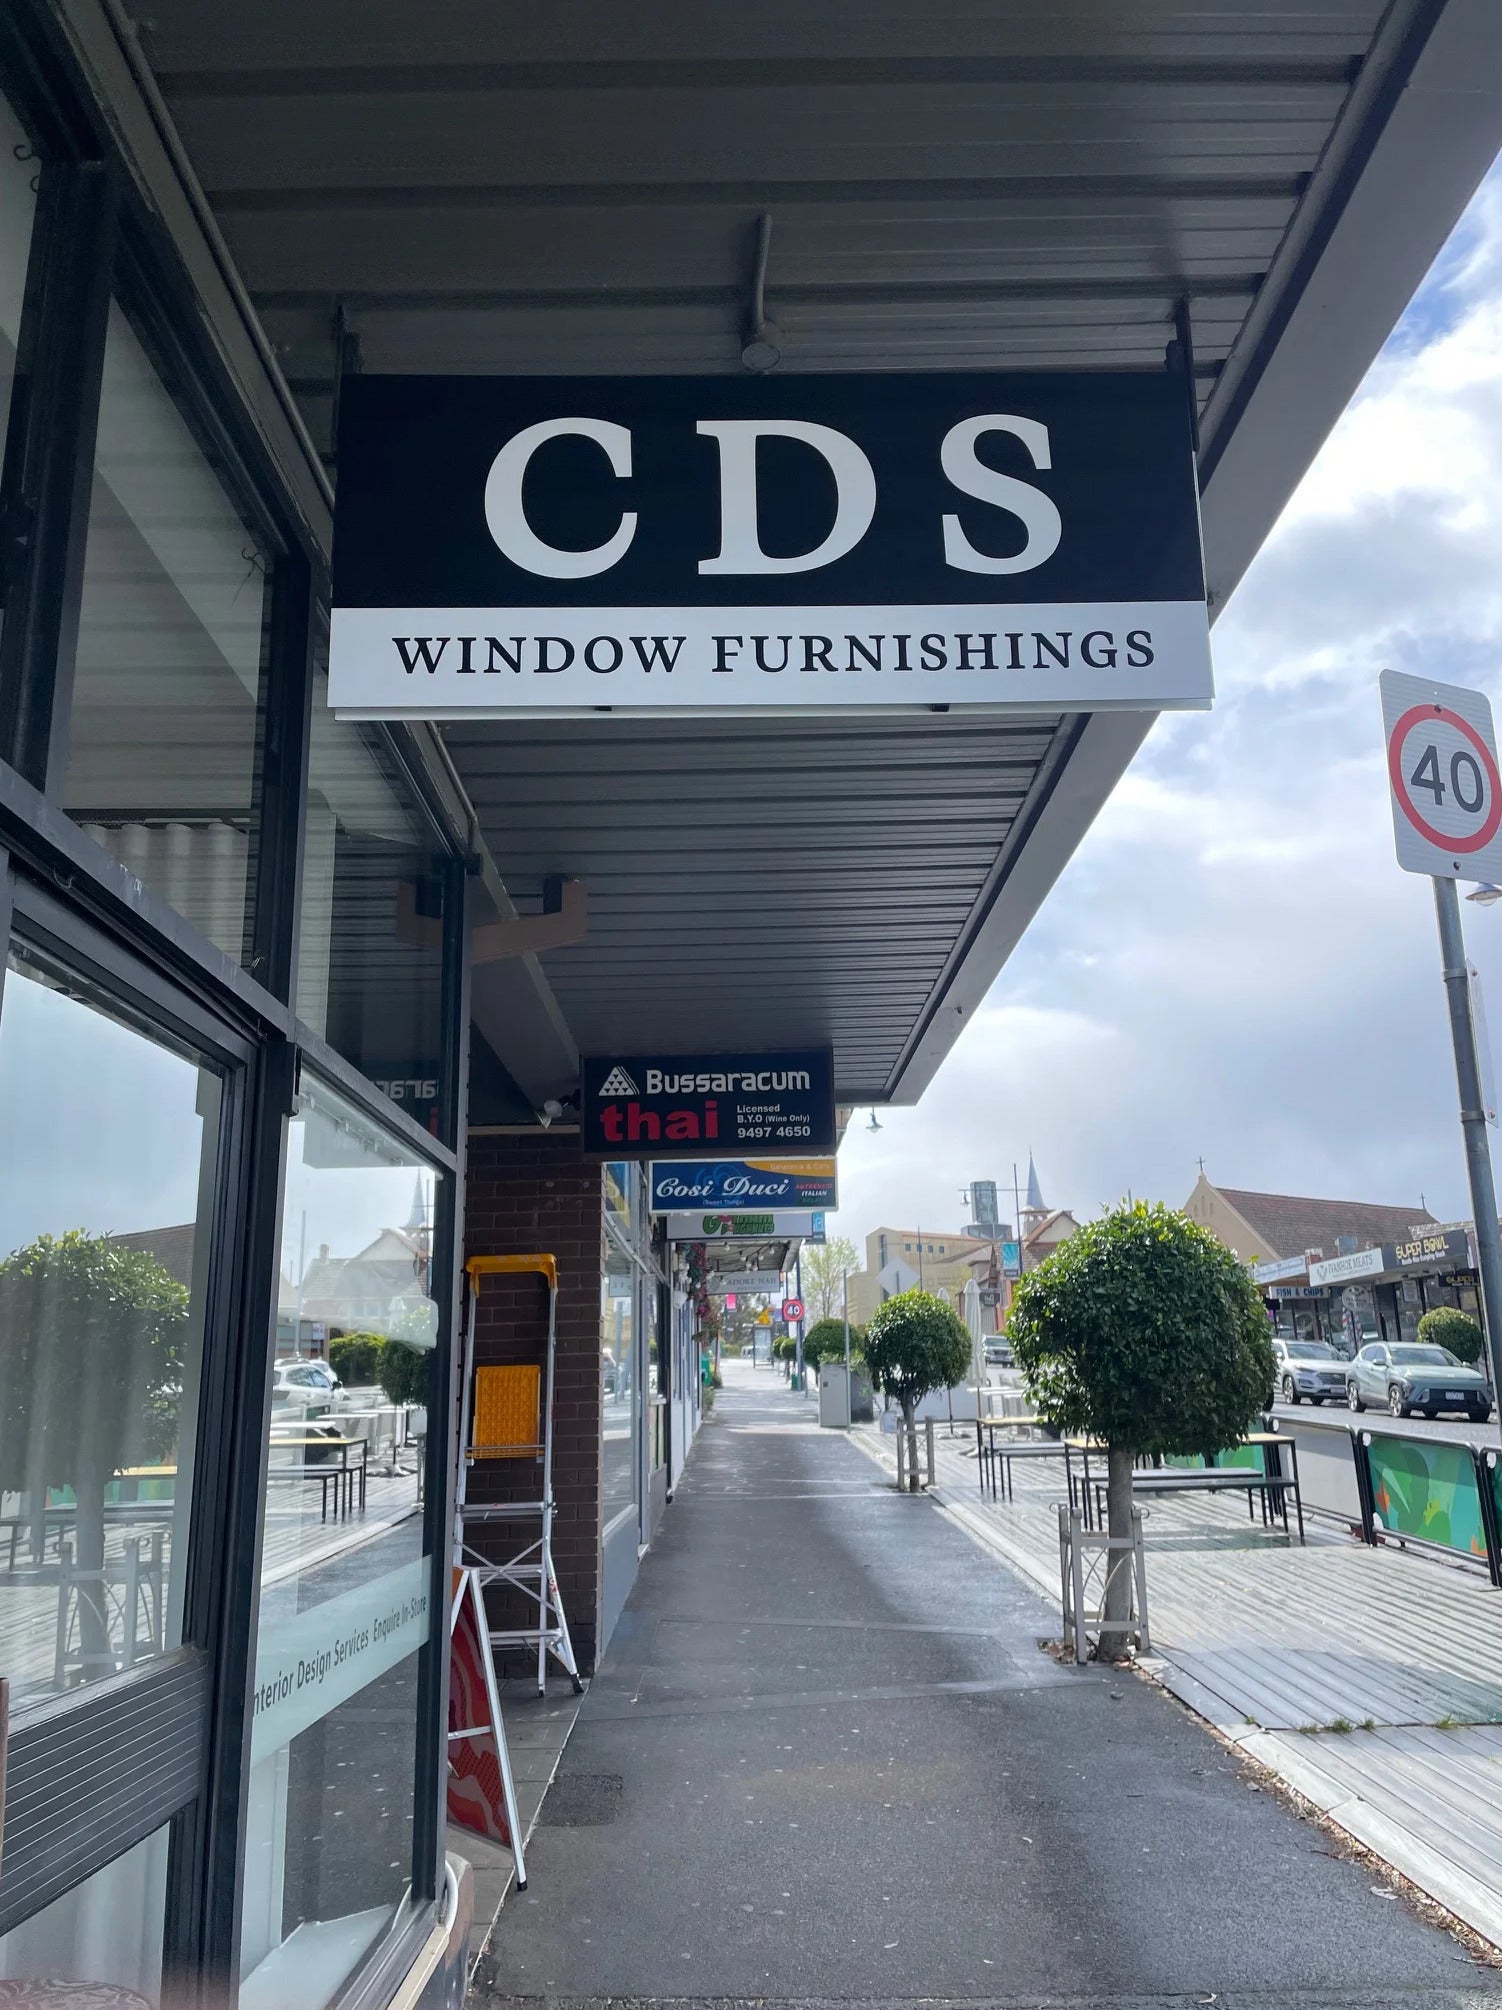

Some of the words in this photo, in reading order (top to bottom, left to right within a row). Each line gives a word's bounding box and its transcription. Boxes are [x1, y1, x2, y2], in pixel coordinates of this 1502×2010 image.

[483, 413, 1063, 580] CDS
[392, 634, 688, 677] WINDOW
[711, 628, 1156, 674] FURNISHINGS
[1410, 744, 1484, 814] 40
[645, 1069, 811, 1095] Bussaracum
[736, 1103, 780, 1113] Licensed
[765, 1115, 788, 1124] (Wine
[789, 1114, 810, 1123] Only)
[599, 1100, 719, 1142] thai
[737, 1127, 772, 1138] 9497
[776, 1125, 811, 1137] 4650
[655, 1177, 715, 1198] Cosi
[721, 1174, 791, 1197] Duci
[1395, 1240, 1422, 1260] SUPER
[1423, 1235, 1449, 1254] BOWL
[1352, 1253, 1373, 1269] MEATS
[1276, 1287, 1292, 1297] FISH
[1303, 1287, 1324, 1296] CHIPS
[786, 1305, 800, 1315] 40
[254, 1671, 294, 1715] nterior
[297, 1647, 331, 1689] Design
[334, 1628, 369, 1667] Services
[373, 1609, 401, 1643] Enquire
